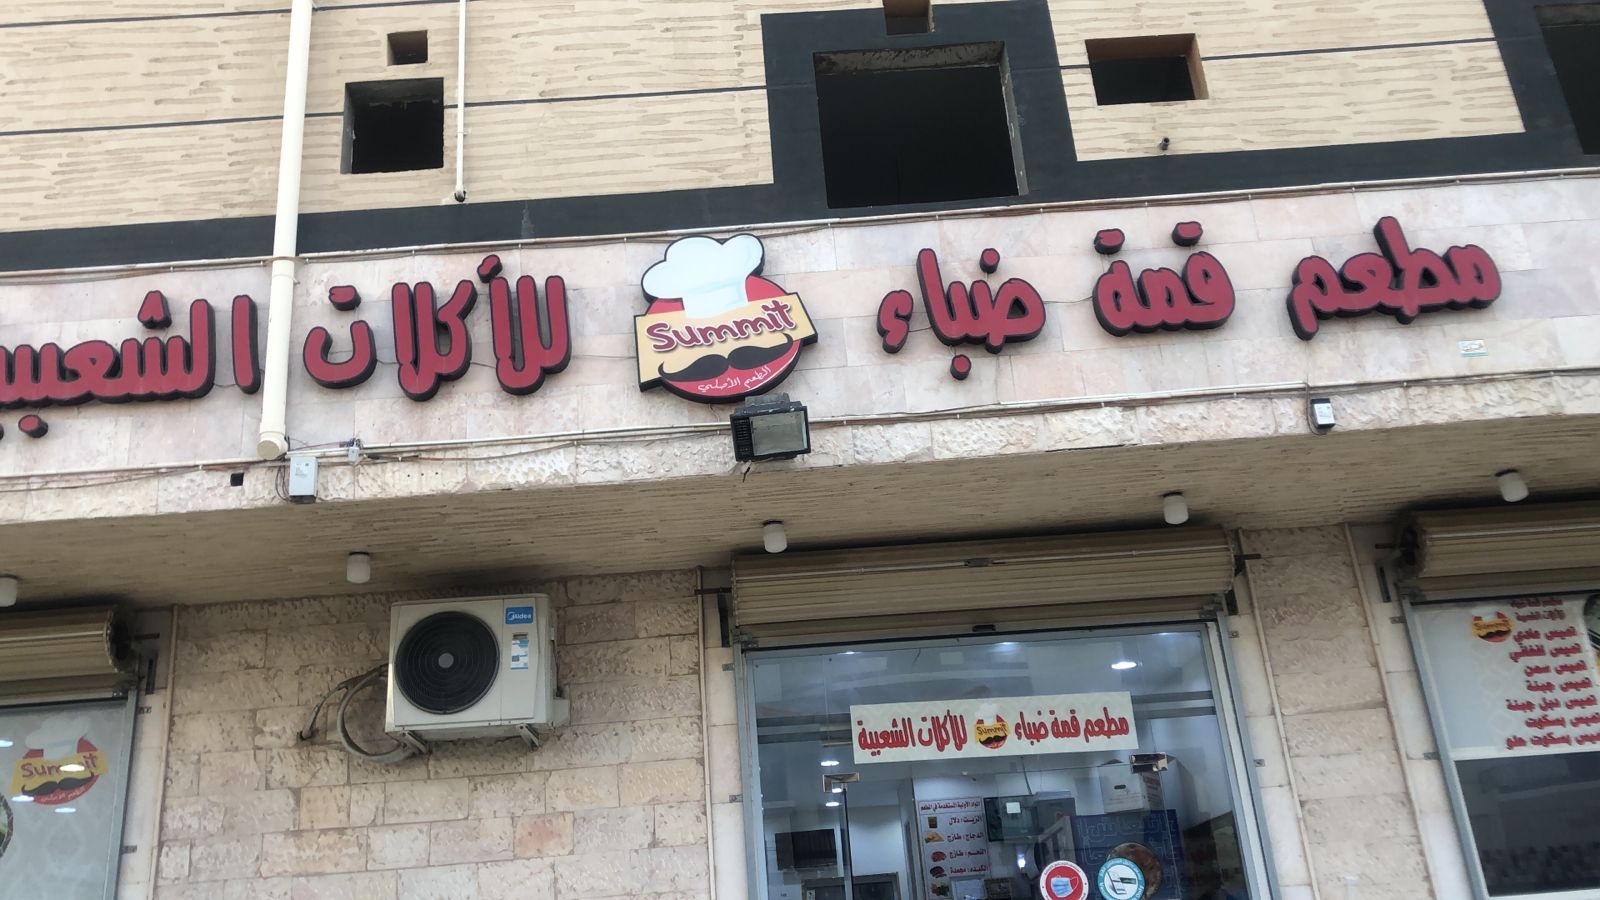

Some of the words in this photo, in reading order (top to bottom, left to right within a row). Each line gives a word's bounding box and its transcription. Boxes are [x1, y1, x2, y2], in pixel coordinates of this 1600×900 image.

[1092, 221, 1236, 337] قمة
[1287, 216, 1502, 341] مطعم
[645, 300, 795, 352] Summit
[877, 248, 1047, 381] ضباء
[744, 366, 772, 388] الطعم
[857, 717, 916, 757] الشعبية
[1014, 710, 1048, 746] ضباء
[1049, 709, 1081, 739] قمة
[1083, 707, 1130, 742] مطعم
